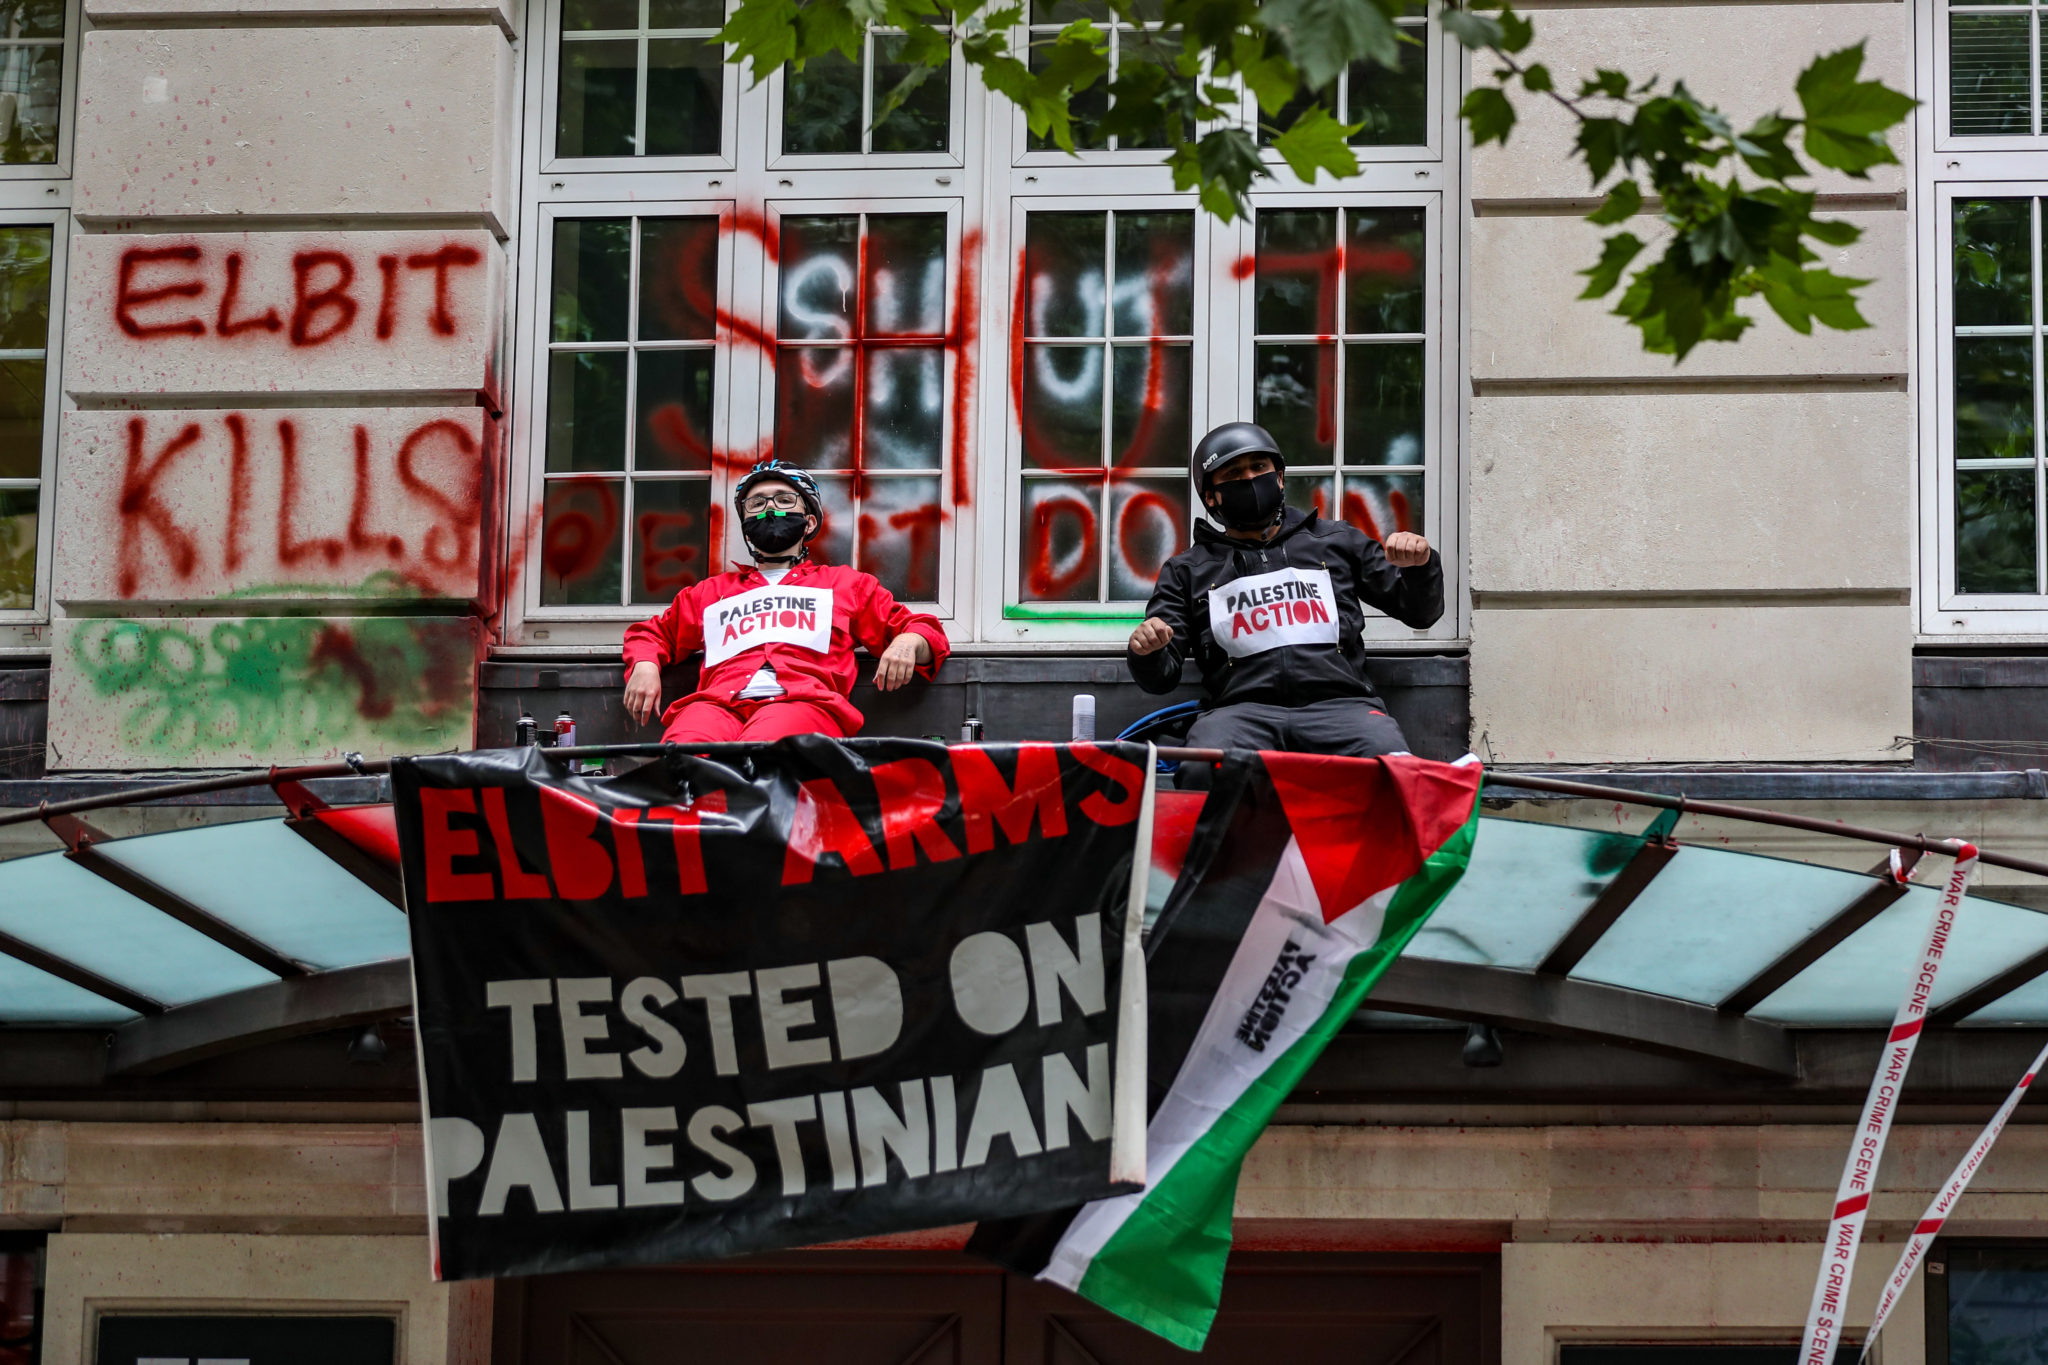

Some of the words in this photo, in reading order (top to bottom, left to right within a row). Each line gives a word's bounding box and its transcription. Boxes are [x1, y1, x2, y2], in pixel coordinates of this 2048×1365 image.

[116, 245, 481, 348] ELBIT
[652, 208, 1413, 506] SHUT
[118, 414, 482, 598] KILLS
[1027, 489, 1413, 597] DON
[720, 597, 816, 625] PALESTINE
[1227, 581, 1321, 613] PALESTINE
[1232, 600, 1329, 639] ACTION
[722, 610, 816, 646] ACTION
[419, 786, 728, 903] ELBIT
[780, 741, 1146, 887] ARMS
[1944, 870, 1966, 906] WAR
[1927, 909, 1954, 960] CRIME
[487, 955, 903, 1083] TESTED
[949, 912, 1106, 1036] ON
[1908, 961, 1938, 1015] SCENE
[1885, 1047, 1908, 1082] WAR
[431, 1043, 1112, 1218] PALESTINIAN
[1867, 1085, 1894, 1135] CRIME
[1850, 1137, 1877, 1191] SCENE
[1936, 1180, 1961, 1213] WAR
[1961, 1136, 1992, 1180] CRIME
[1834, 1223, 1855, 1260] WAR
[1893, 1237, 1924, 1288] SCENE
[1820, 1263, 1845, 1315] CRIME
[1807, 1316, 1833, 1365] SCENE
